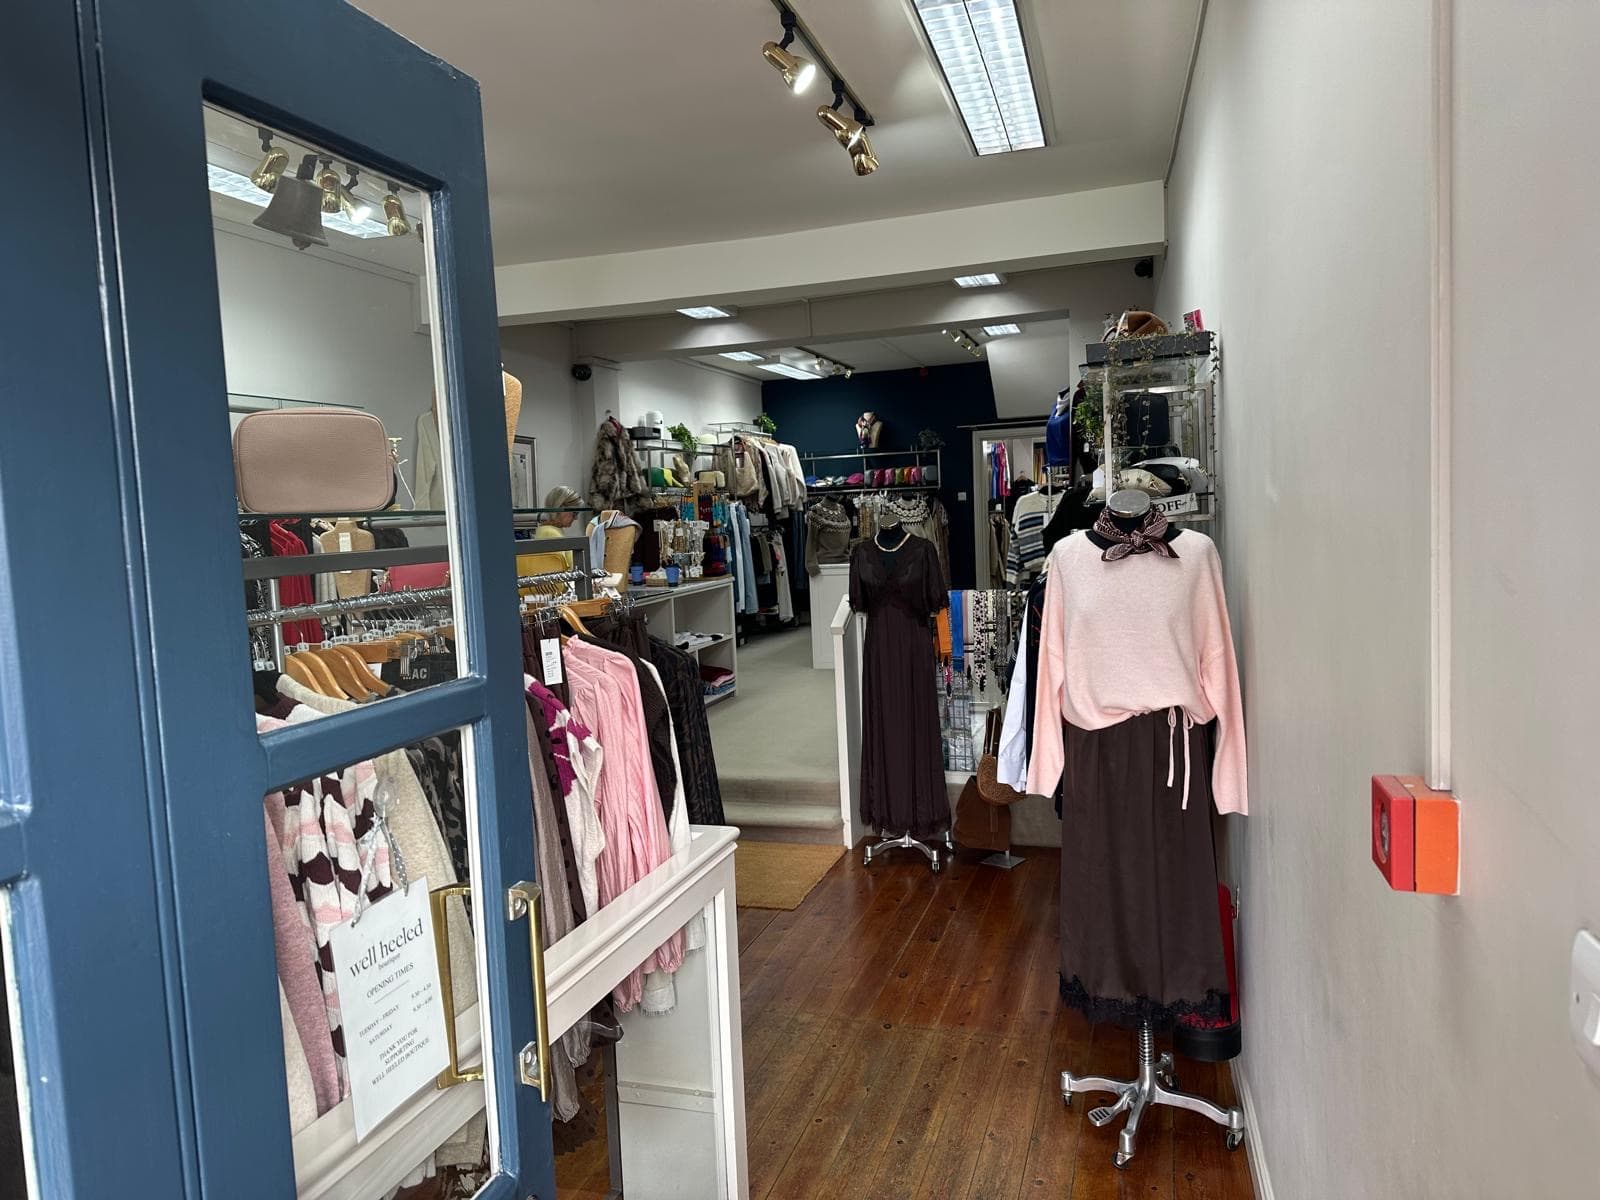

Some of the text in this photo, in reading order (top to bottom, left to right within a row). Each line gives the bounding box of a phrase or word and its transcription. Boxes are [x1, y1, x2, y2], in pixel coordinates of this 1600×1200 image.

[349, 917, 423, 977] well heeled
[366, 961, 413, 998] OPENING TIMES
[382, 1004, 399, 1020] FRIDAY
[371, 1035, 429, 1086] WELL HEELED BOUTIQUE
[379, 1026, 417, 1061] THANK YOU FOR
[384, 1037, 414, 1066] SUPPORTING
